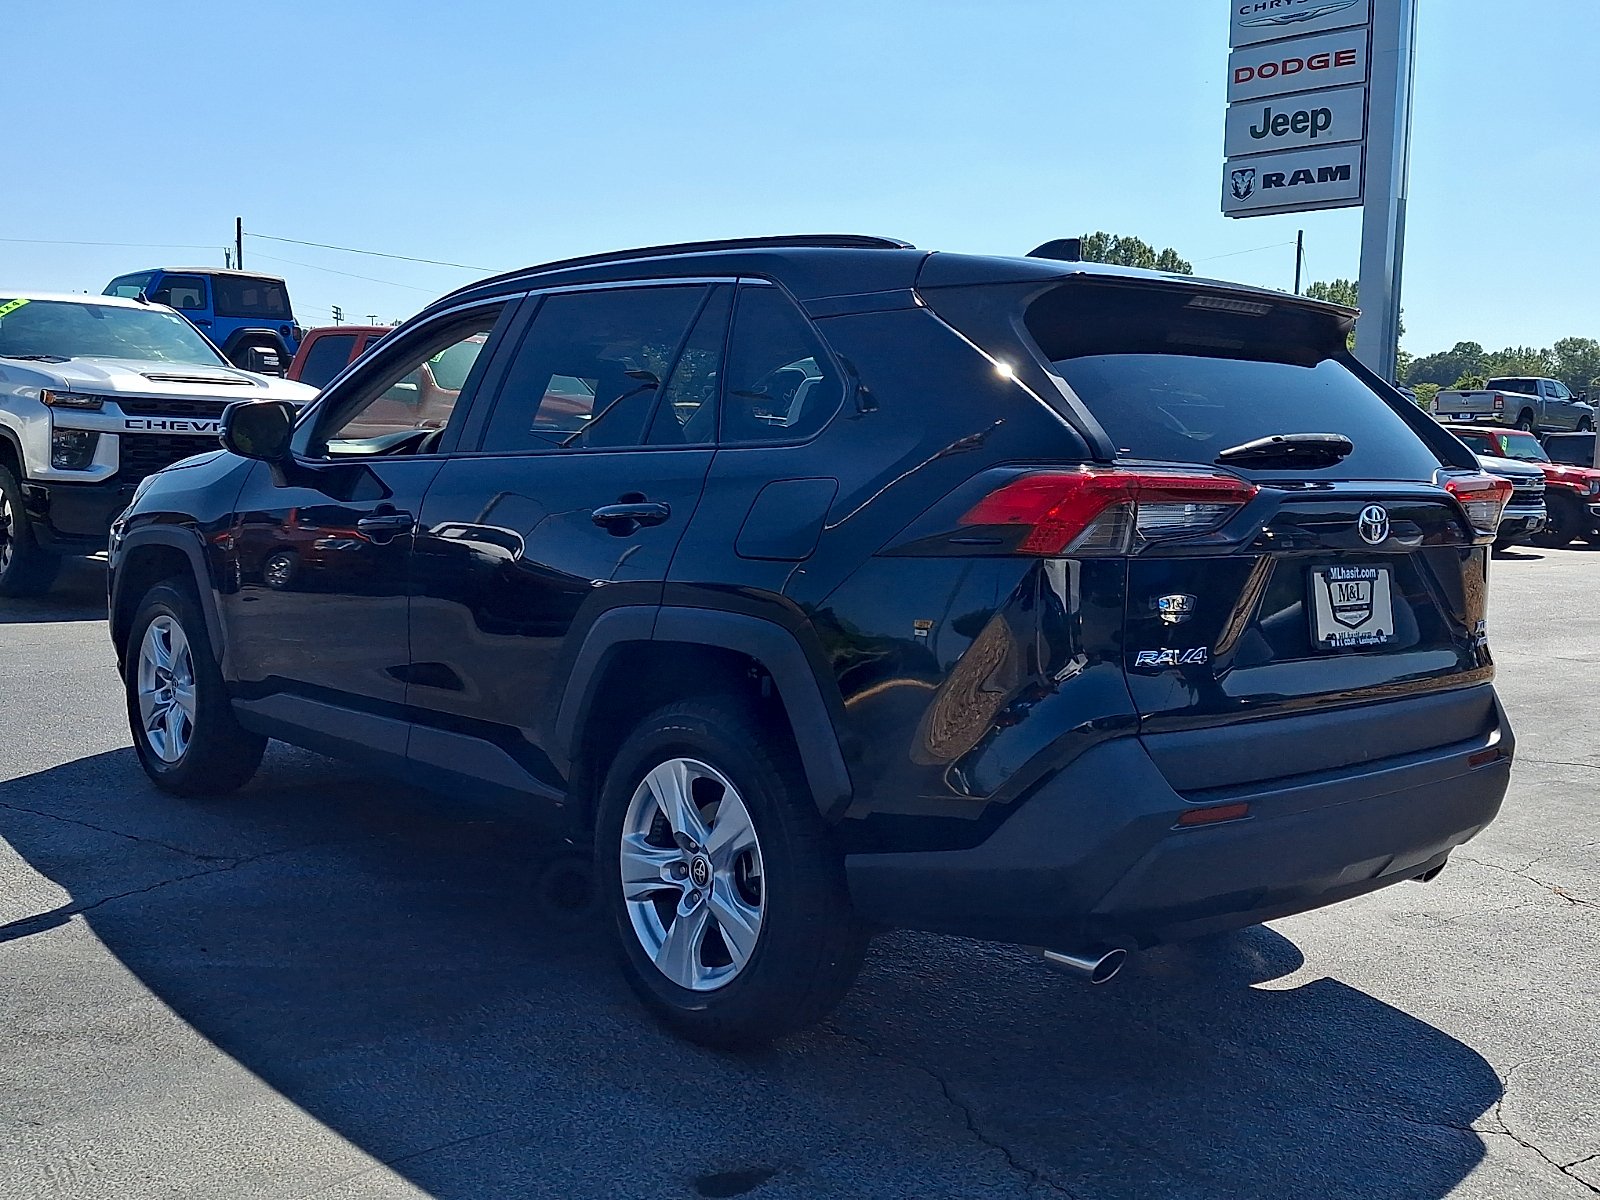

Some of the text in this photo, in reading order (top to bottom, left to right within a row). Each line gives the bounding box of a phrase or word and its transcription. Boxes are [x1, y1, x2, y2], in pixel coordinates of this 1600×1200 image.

[1234, 49, 1357, 84] DODGE
[1250, 107, 1331, 139] Jeep
[1262, 164, 1351, 189] RAM
[1330, 566, 1376, 579] MLhasit.com
[1337, 582, 1365, 602] M&L
[1135, 646, 1208, 667] RAV4
